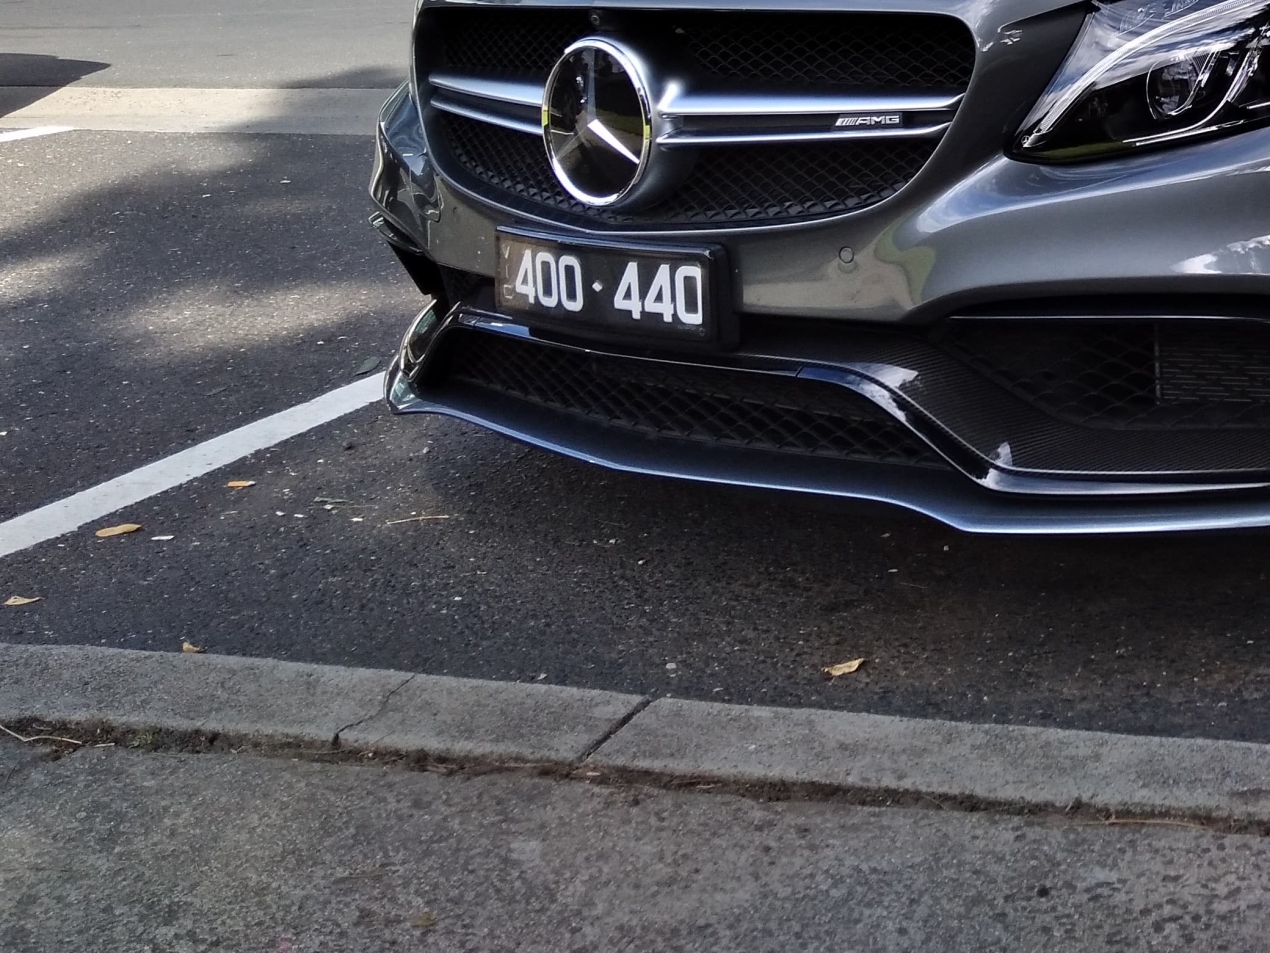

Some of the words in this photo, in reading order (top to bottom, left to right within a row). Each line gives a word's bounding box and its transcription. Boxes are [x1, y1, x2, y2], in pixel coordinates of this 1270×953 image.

[856, 115, 900, 126] AMG
[501, 245, 514, 299] VIC
[515, 249, 584, 312] 400
[614, 261, 703, 325] 440
